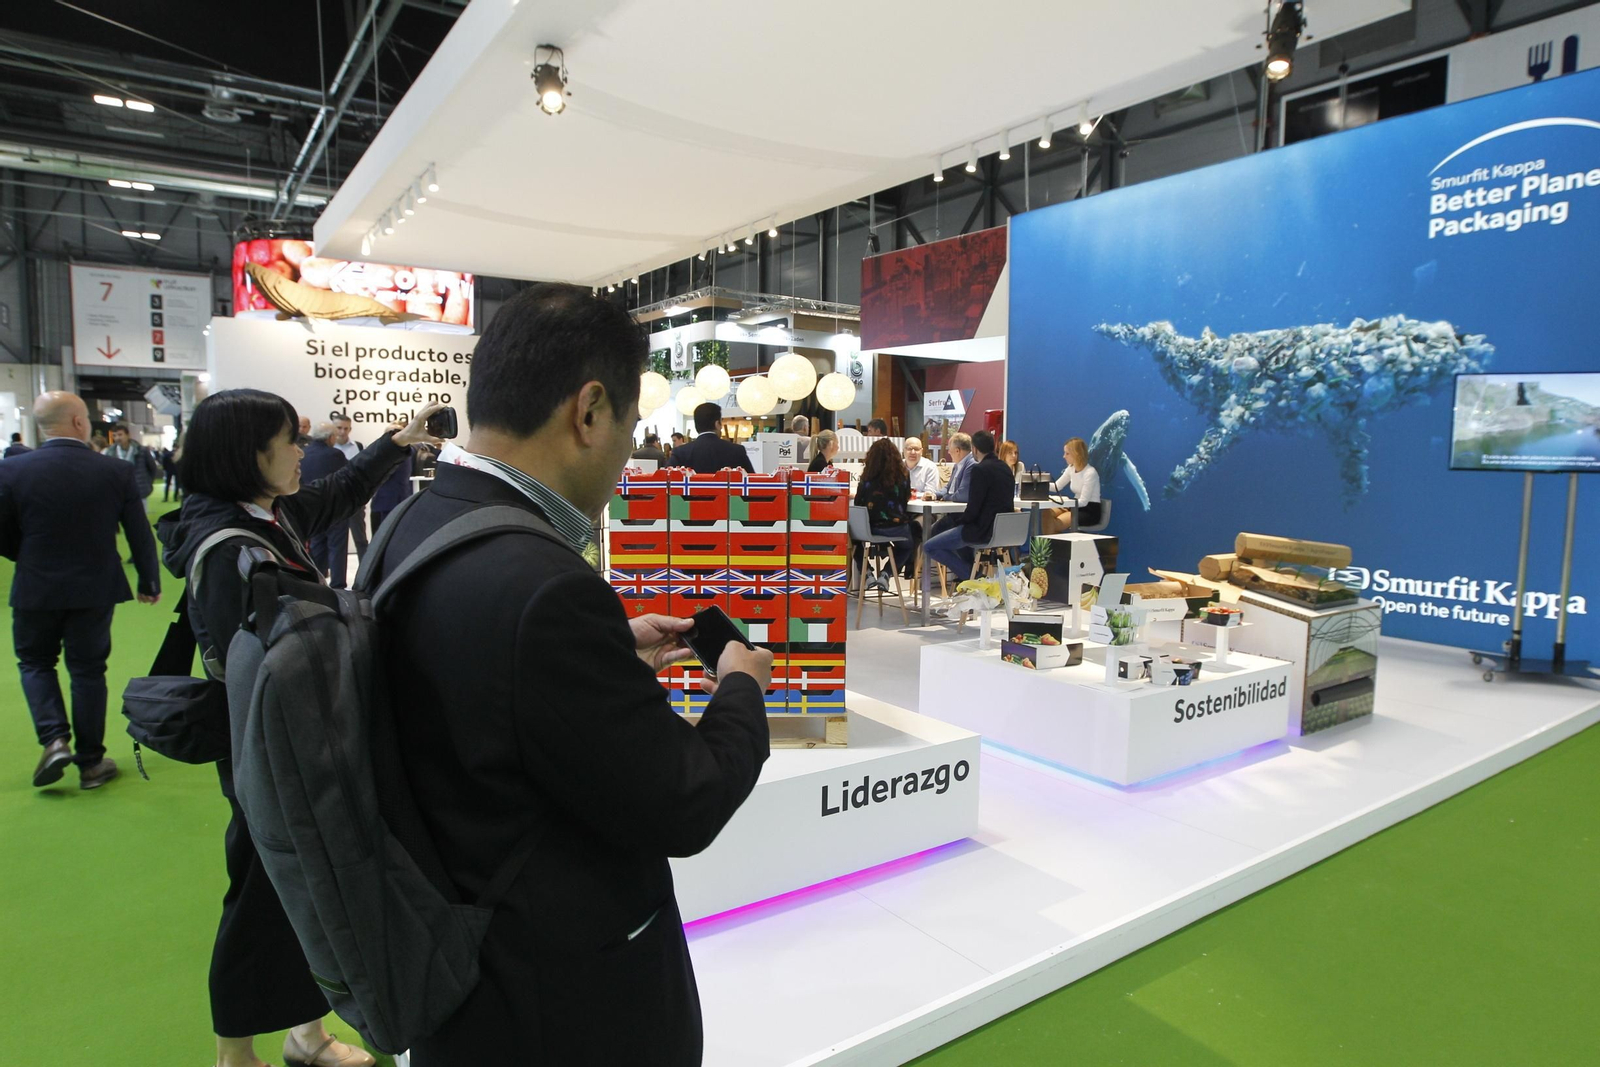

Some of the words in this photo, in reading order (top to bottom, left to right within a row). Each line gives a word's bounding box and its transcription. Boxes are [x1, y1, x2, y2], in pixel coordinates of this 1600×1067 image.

[1430, 168, 1490, 191] Smurfit
[1491, 158, 1546, 179] Kappa
[1429, 184, 1518, 215] Better
[1428, 201, 1570, 239] Packaging
[99, 281, 113, 301] 7
[306, 339, 326, 356] Si
[331, 341, 349, 357] el
[355, 345, 448, 362] producto
[453, 352, 473, 364] es
[314, 362, 468, 388] biodegradable,
[333, 388, 381, 405] ¿por
[386, 387, 423, 406] qué
[428, 392, 452, 404] no
[353, 409, 415, 424] embal
[1372, 569, 1480, 603] Smurfit
[1371, 595, 1417, 614] Open
[1420, 602, 1449, 618] the
[1452, 605, 1511, 626] future
[1173, 675, 1288, 723] Sostenibilidad
[821, 759, 970, 817] Liderazgo
